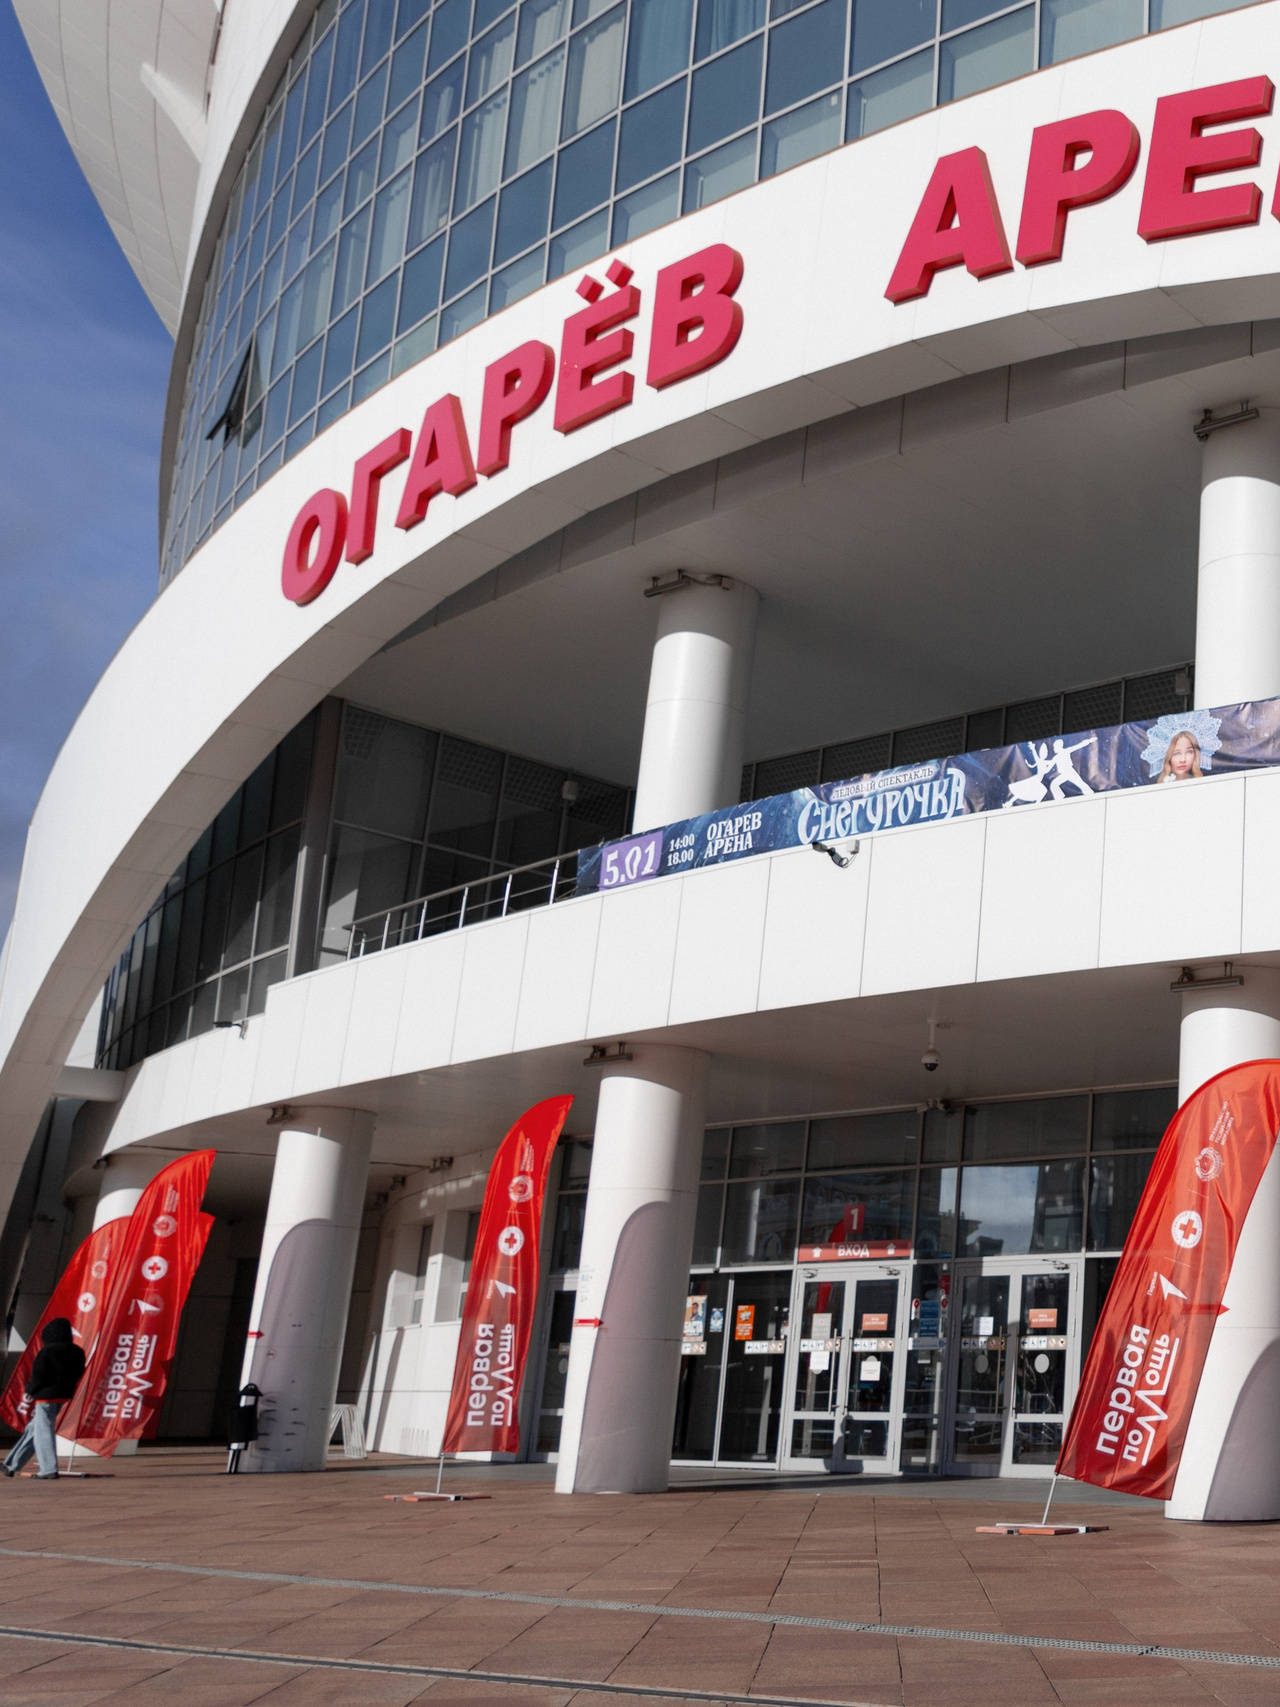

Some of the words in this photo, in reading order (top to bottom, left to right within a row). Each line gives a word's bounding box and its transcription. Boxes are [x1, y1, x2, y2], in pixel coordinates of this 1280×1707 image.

[281, 243, 744, 606] ОГАРЁВ
[832, 780, 876, 799] ЛЕДОВЫЙ
[878, 768, 934, 789] СПЕКТАКЛЬ
[670, 833, 695, 852] 14:00
[703, 832, 753, 859] АРЕНА
[707, 811, 762, 841] ОГАРЕВ
[603, 840, 656, 886] 5.01
[667, 849, 694, 866] 18.00
[851, 1208, 859, 1230] 1
[837, 1243, 870, 1258] ВХОД
[102, 1334, 134, 1419] первая
[120, 1334, 157, 1420] помощь
[466, 1323, 495, 1427] первая
[490, 1323, 515, 1427] помощь
[1095, 1324, 1150, 1456] первая
[1122, 1334, 1180, 1467] помощь
